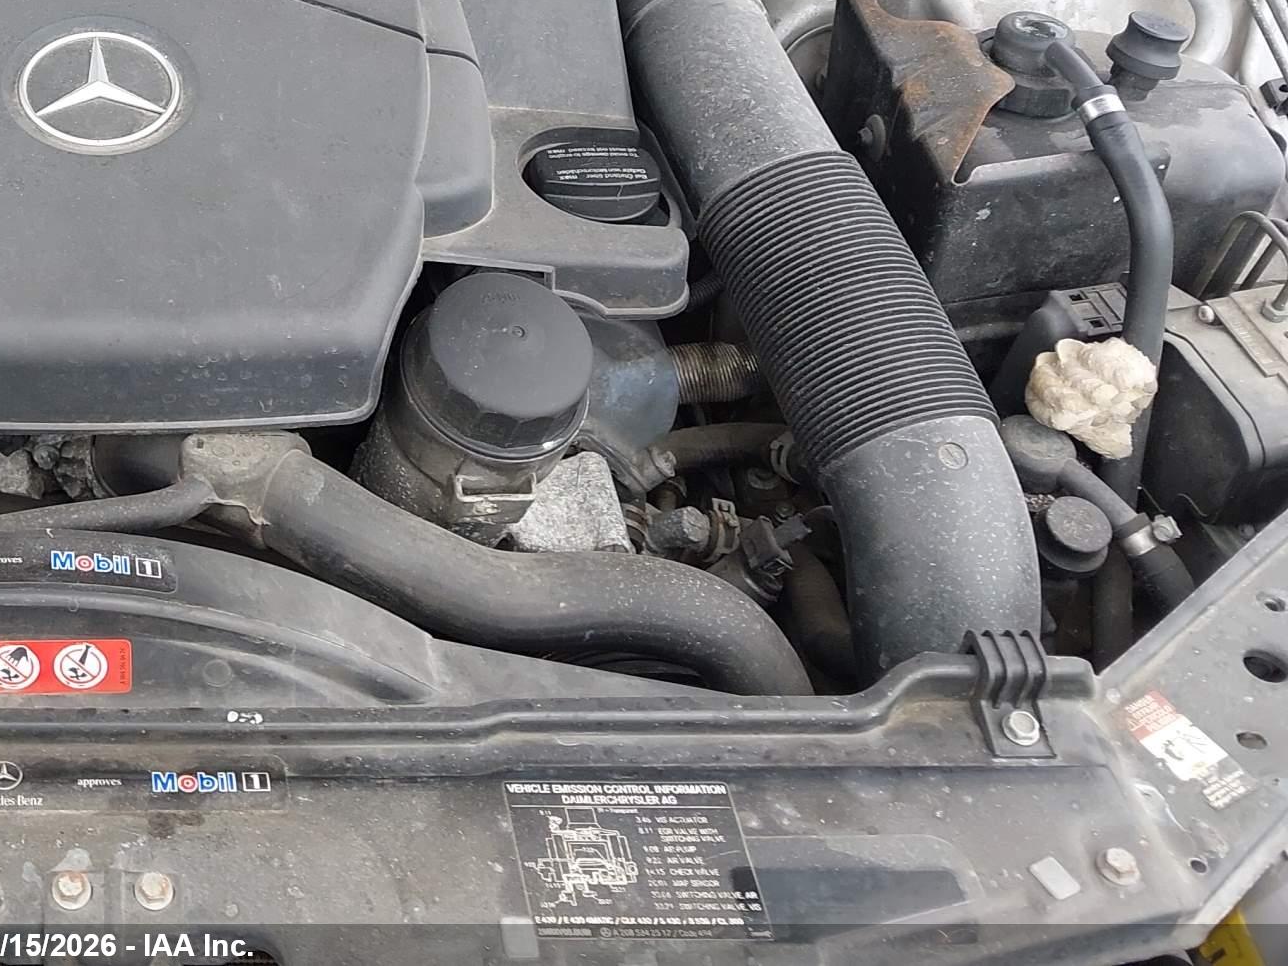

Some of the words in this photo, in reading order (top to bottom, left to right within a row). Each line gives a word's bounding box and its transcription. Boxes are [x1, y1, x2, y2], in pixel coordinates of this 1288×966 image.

[50, 550, 130, 576] Mobil
[138, 559, 155, 577] 1
[77, 778, 122, 788] approves
[151, 771, 238, 794] Mobil
[246, 774, 264, 790] 1
[506, 784, 551, 794] VEHICLE
[552, 784, 602, 794] EMISSION
[603, 784, 651, 794] CONTROL
[653, 784, 727, 794] INFORMATION
[17, 794, 44, 806] Benz
[561, 795, 660, 805] DAIMLERCHRYSLER
[661, 795, 677, 805] AG
